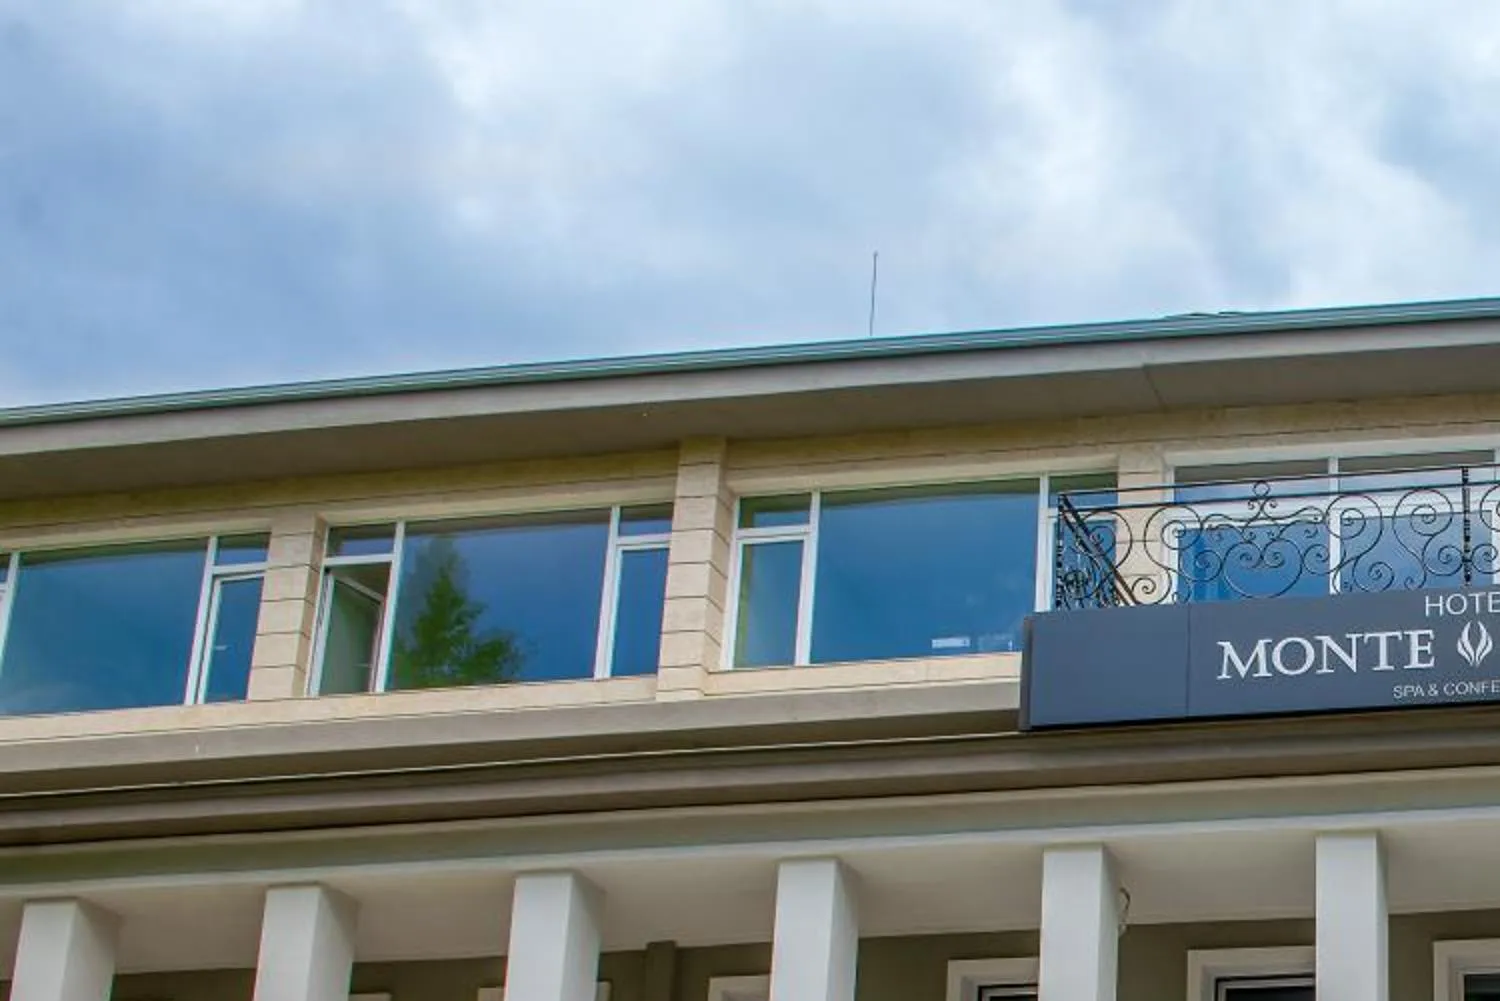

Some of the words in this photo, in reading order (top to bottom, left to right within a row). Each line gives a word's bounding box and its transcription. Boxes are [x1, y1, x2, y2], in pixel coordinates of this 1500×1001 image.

[1216, 629, 1435, 680] MONTE
[1393, 684, 1425, 699] SPA
[1427, 683, 1439, 697] &
